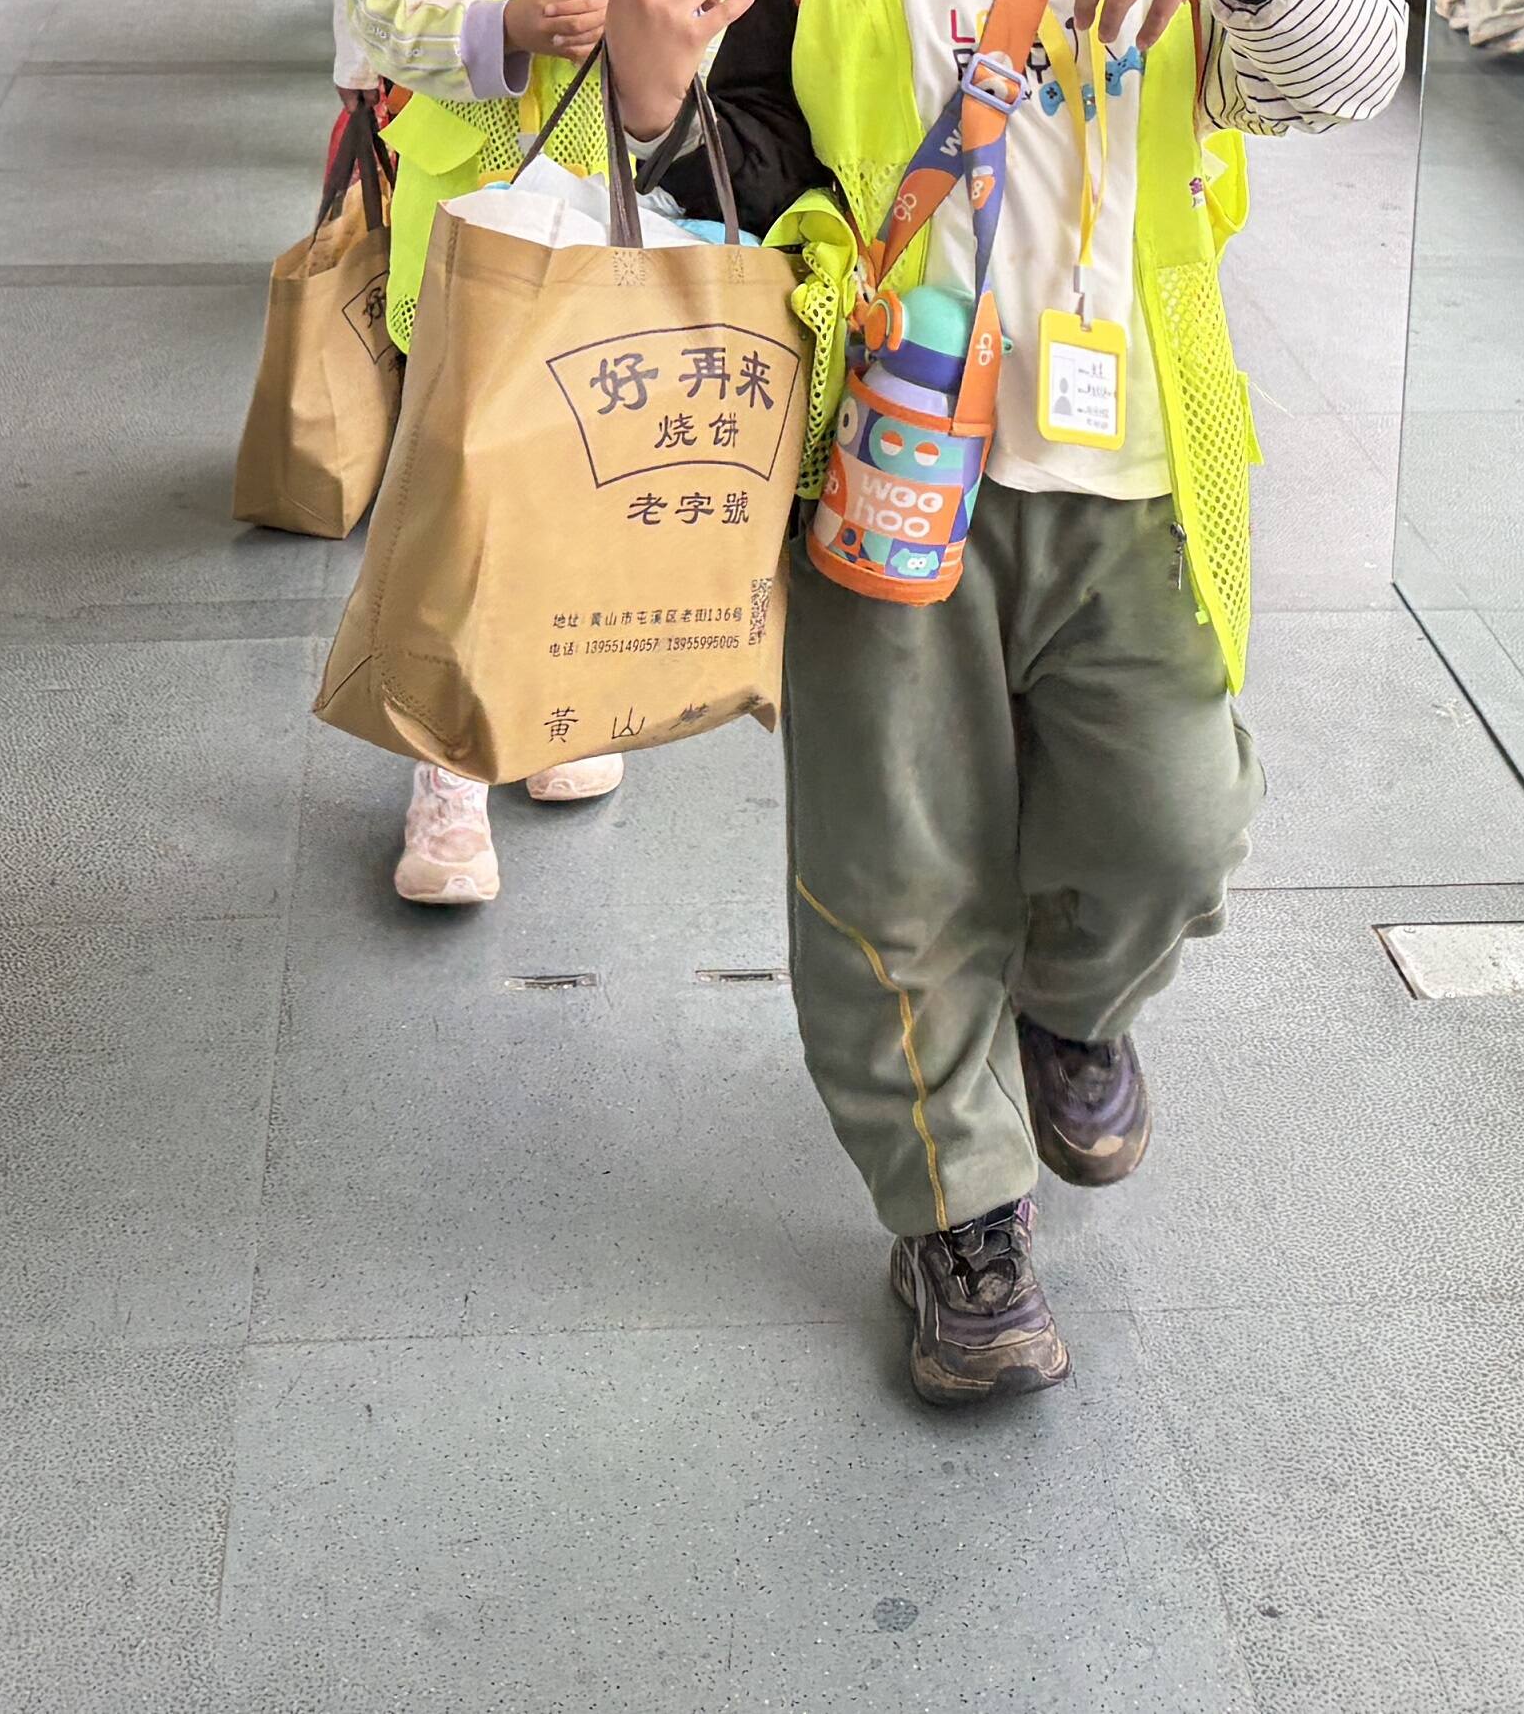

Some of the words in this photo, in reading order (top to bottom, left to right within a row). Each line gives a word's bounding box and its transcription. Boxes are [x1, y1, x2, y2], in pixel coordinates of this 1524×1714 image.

[590, 347, 774, 414] 好再来
[654, 412, 739, 448] 烧饼
[627, 490, 749, 525] 老字號
